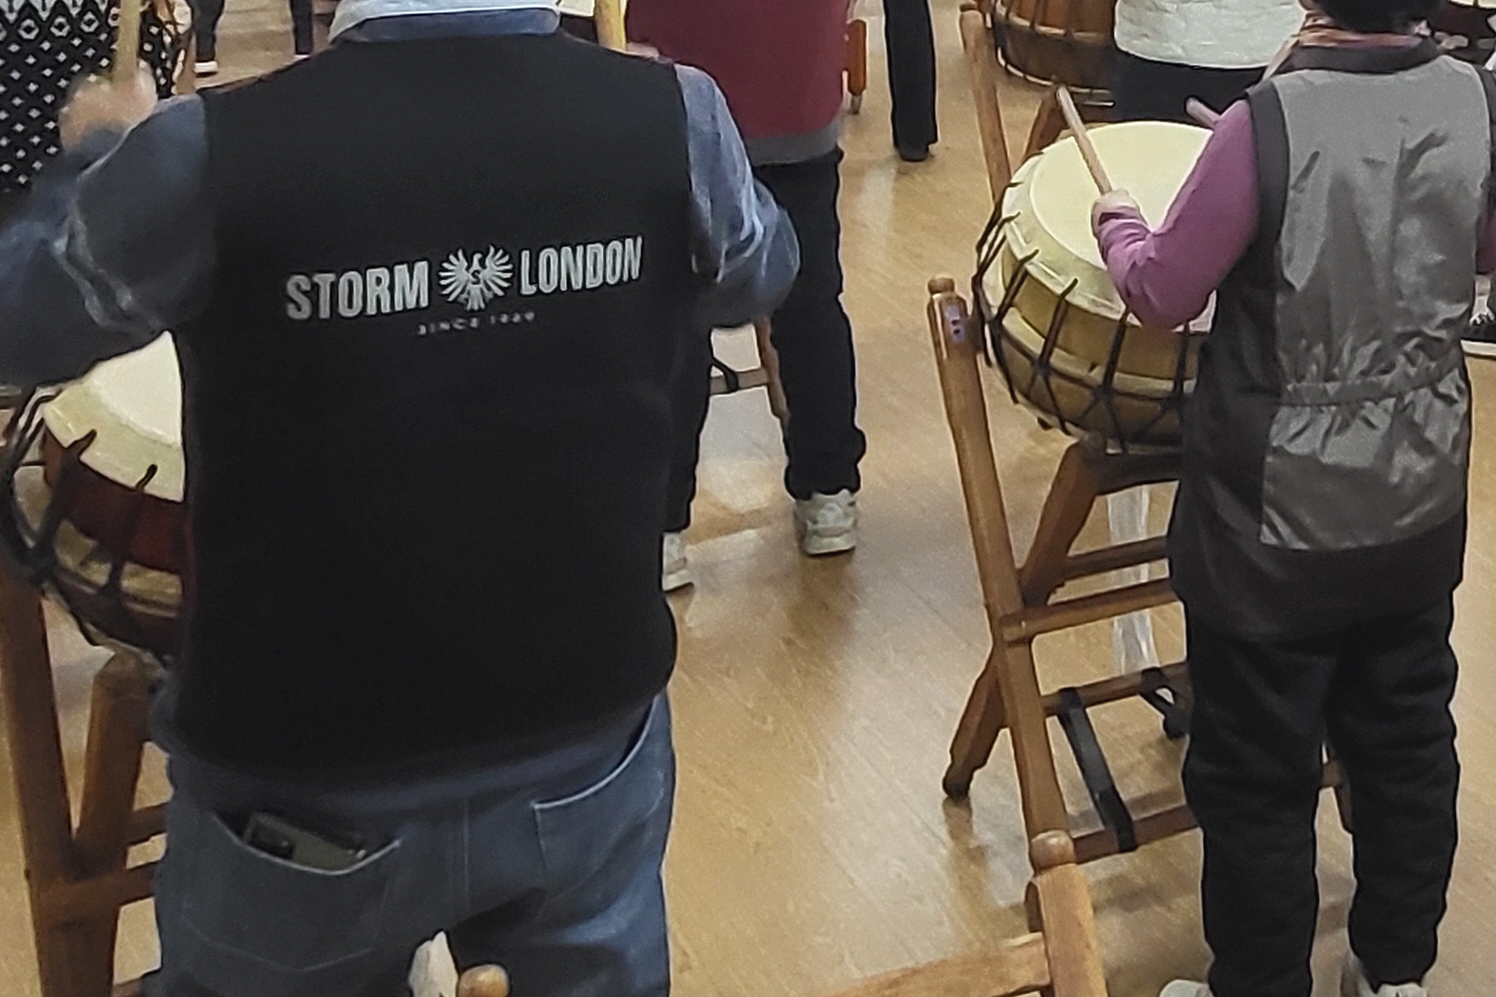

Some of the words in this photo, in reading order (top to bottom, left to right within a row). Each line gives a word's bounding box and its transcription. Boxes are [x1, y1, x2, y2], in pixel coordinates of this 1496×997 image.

[286, 260, 429, 320] STORM
[520, 235, 643, 295] LONDON
[418, 317, 479, 335] SINCE
